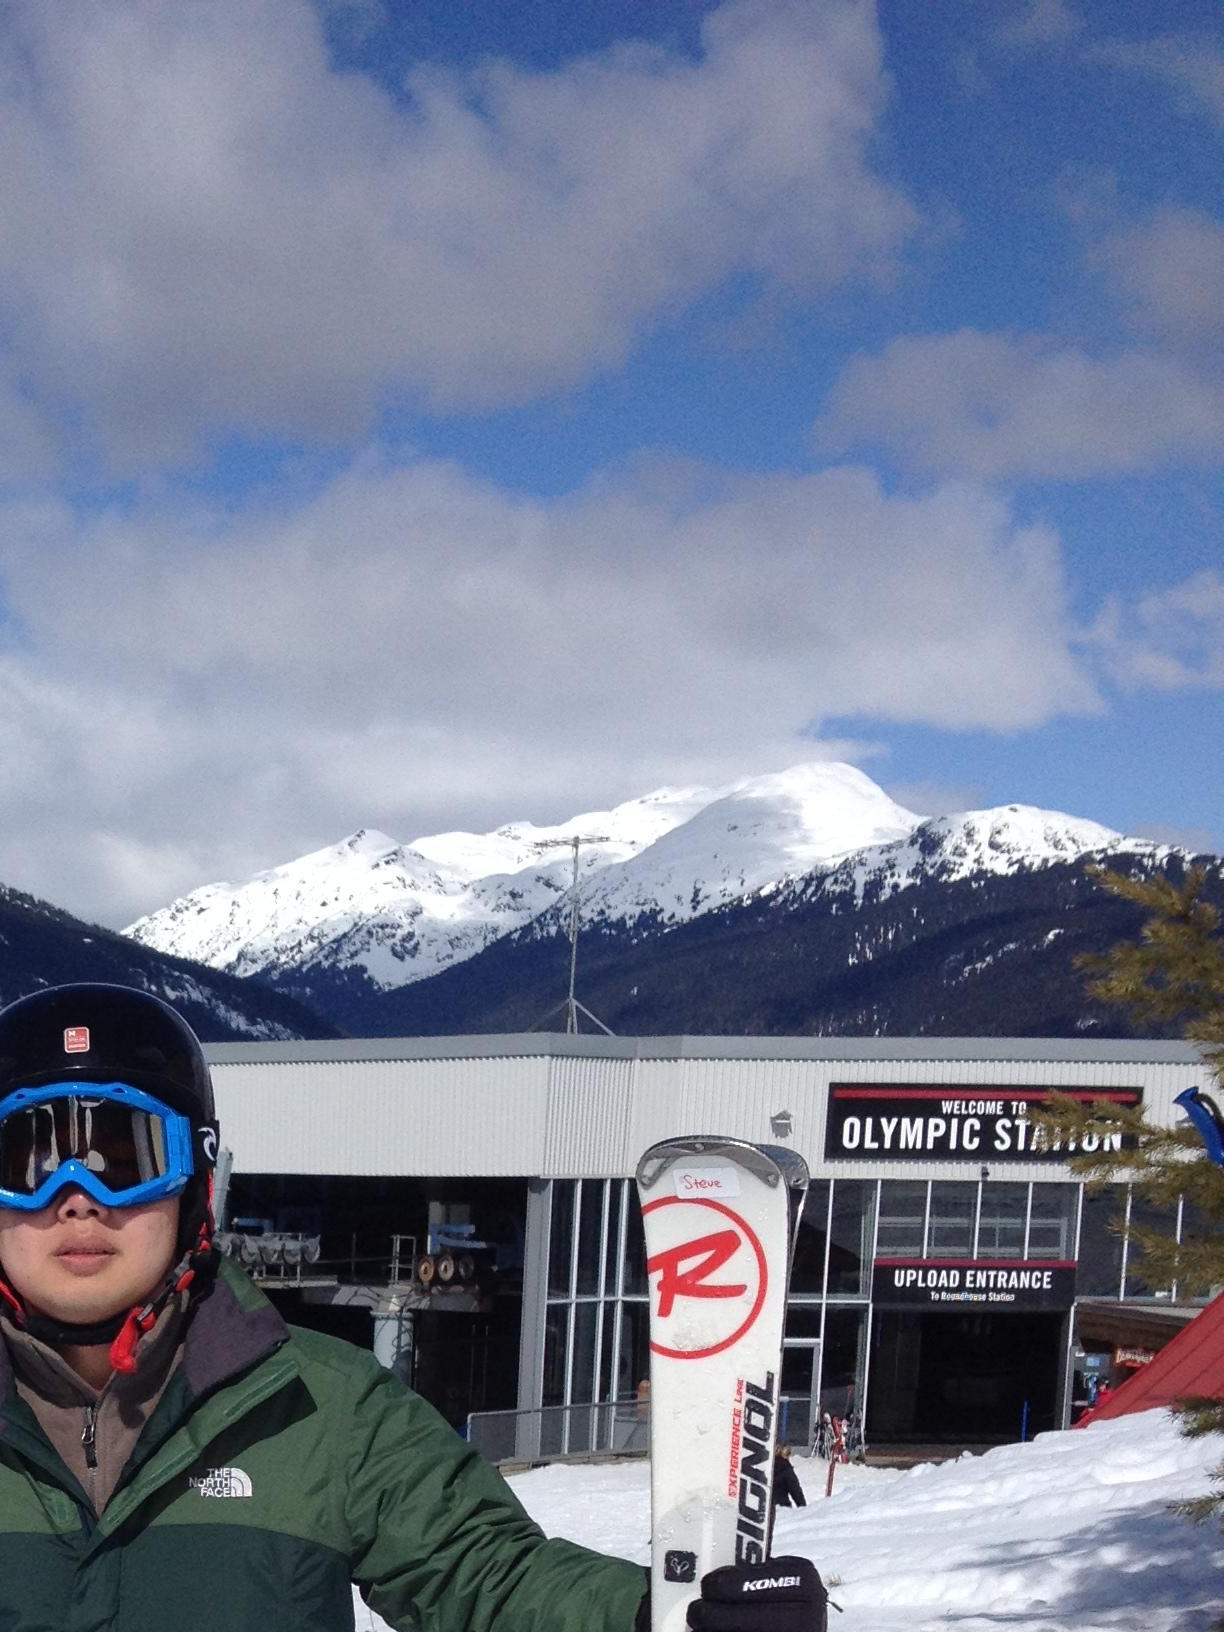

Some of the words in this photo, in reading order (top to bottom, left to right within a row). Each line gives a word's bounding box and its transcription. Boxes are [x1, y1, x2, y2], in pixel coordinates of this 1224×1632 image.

[941, 1100, 1004, 1115] WELCOME
[1011, 1101, 1027, 1115] TO
[842, 1117, 980, 1150] OLYMPIC
[683, 1174, 722, 1190] Steve
[894, 1269, 960, 1288] UPLOAD
[965, 1270, 1053, 1289] ENTRANCE
[931, 1292, 939, 1300] To
[988, 1292, 1015, 1301] Station
[729, 1408, 743, 1498] EXPERIENCE
[207, 1467, 231, 1477] THE
[189, 1477, 231, 1487] NORTH
[200, 1487, 231, 1497] FACE
[742, 1576, 801, 1592] KOMBI
